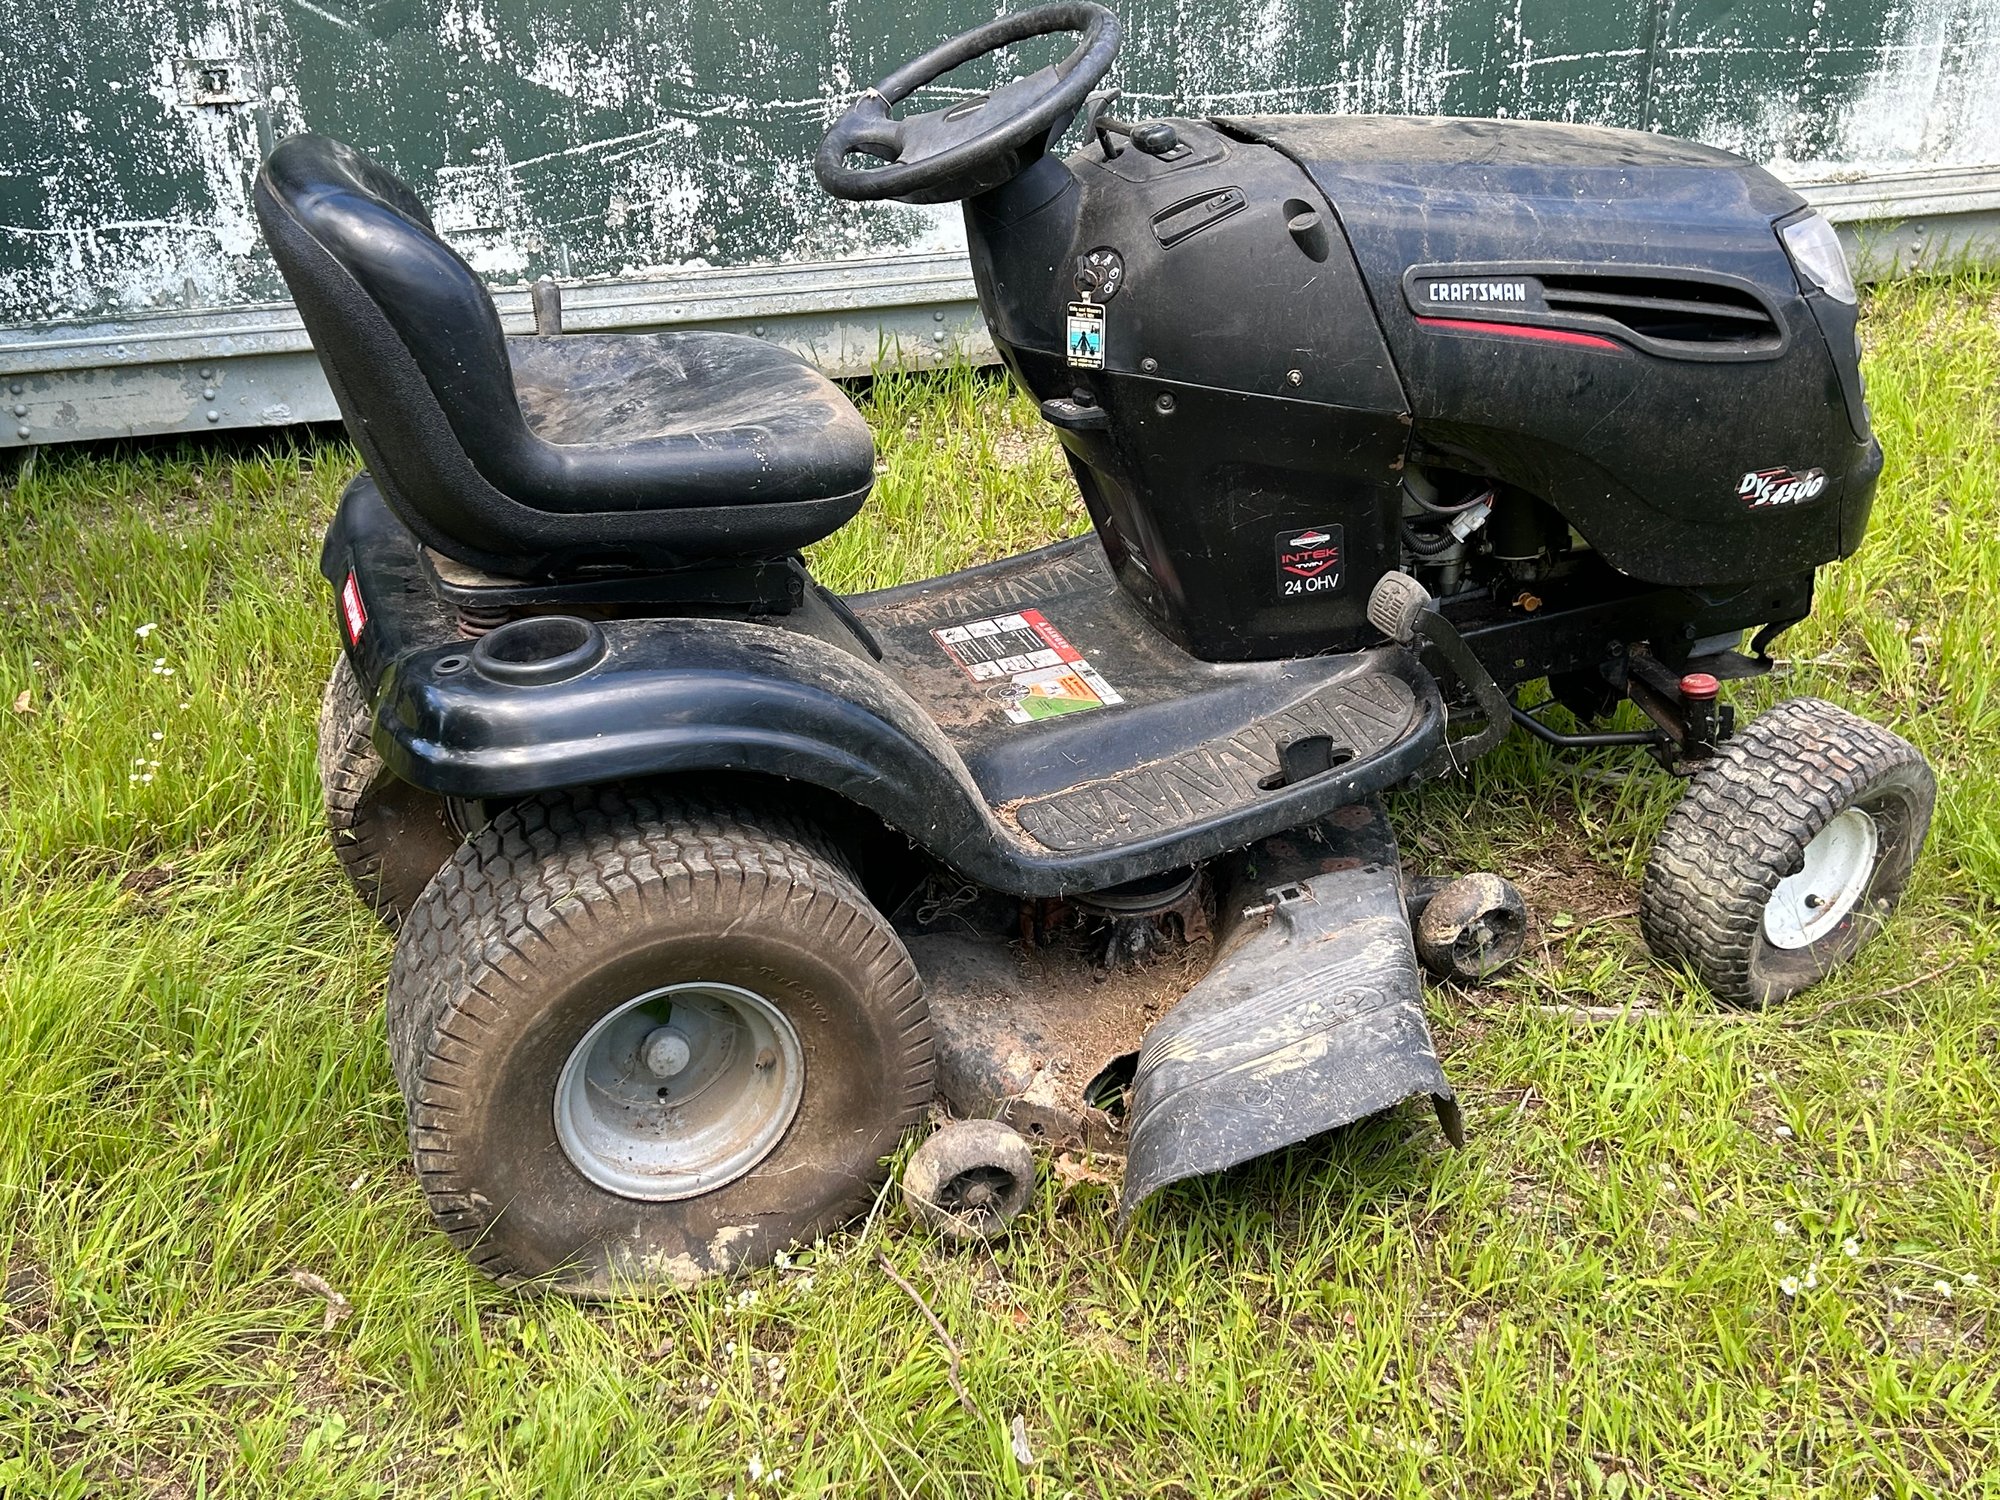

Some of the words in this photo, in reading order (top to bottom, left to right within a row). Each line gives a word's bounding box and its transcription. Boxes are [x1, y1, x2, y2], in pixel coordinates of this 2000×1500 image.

[1429, 283, 1526, 301] CRAFTSMAN
[1282, 547, 1338, 564] INTEK
[1285, 580, 1302, 595] 24
[1306, 573, 1339, 592] OHV
